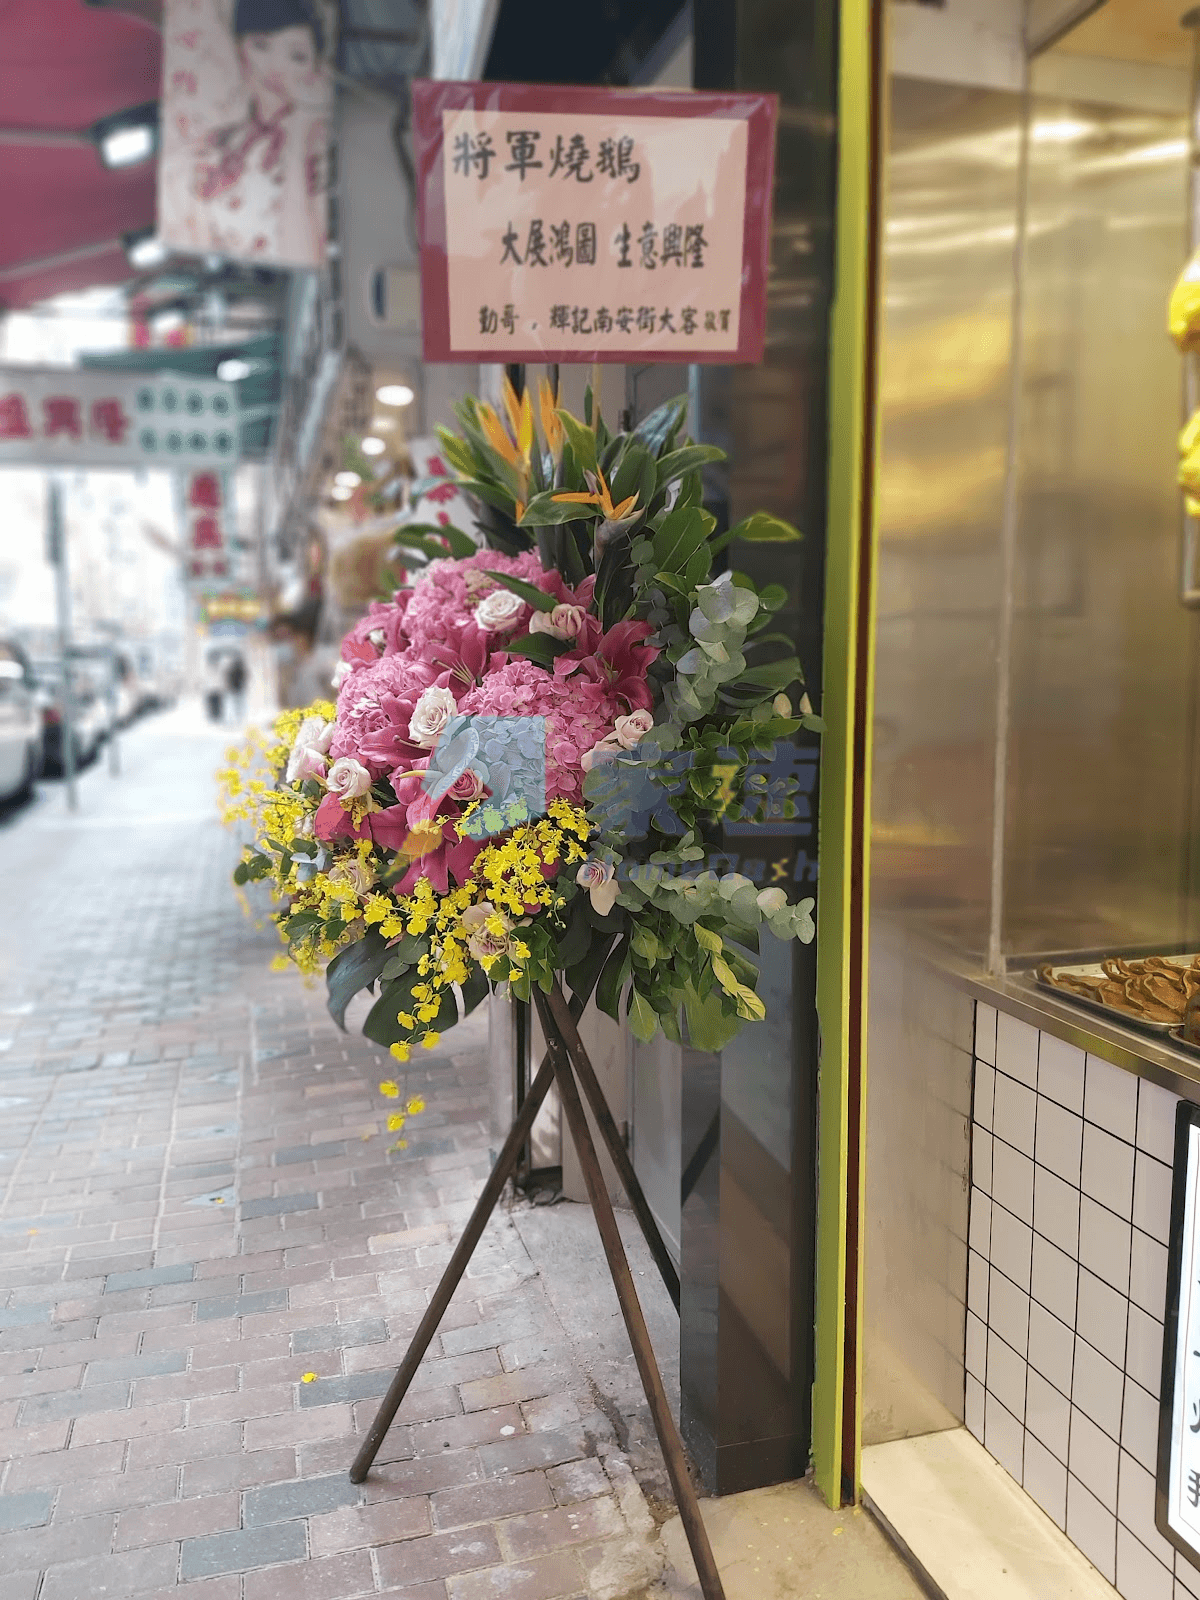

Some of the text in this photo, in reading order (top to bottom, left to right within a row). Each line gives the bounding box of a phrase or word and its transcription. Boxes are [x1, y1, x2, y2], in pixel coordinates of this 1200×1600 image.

[453, 130, 640, 183] 將軍燒鵝
[500, 219, 708, 270] 大展鴻圖 生意興隆
